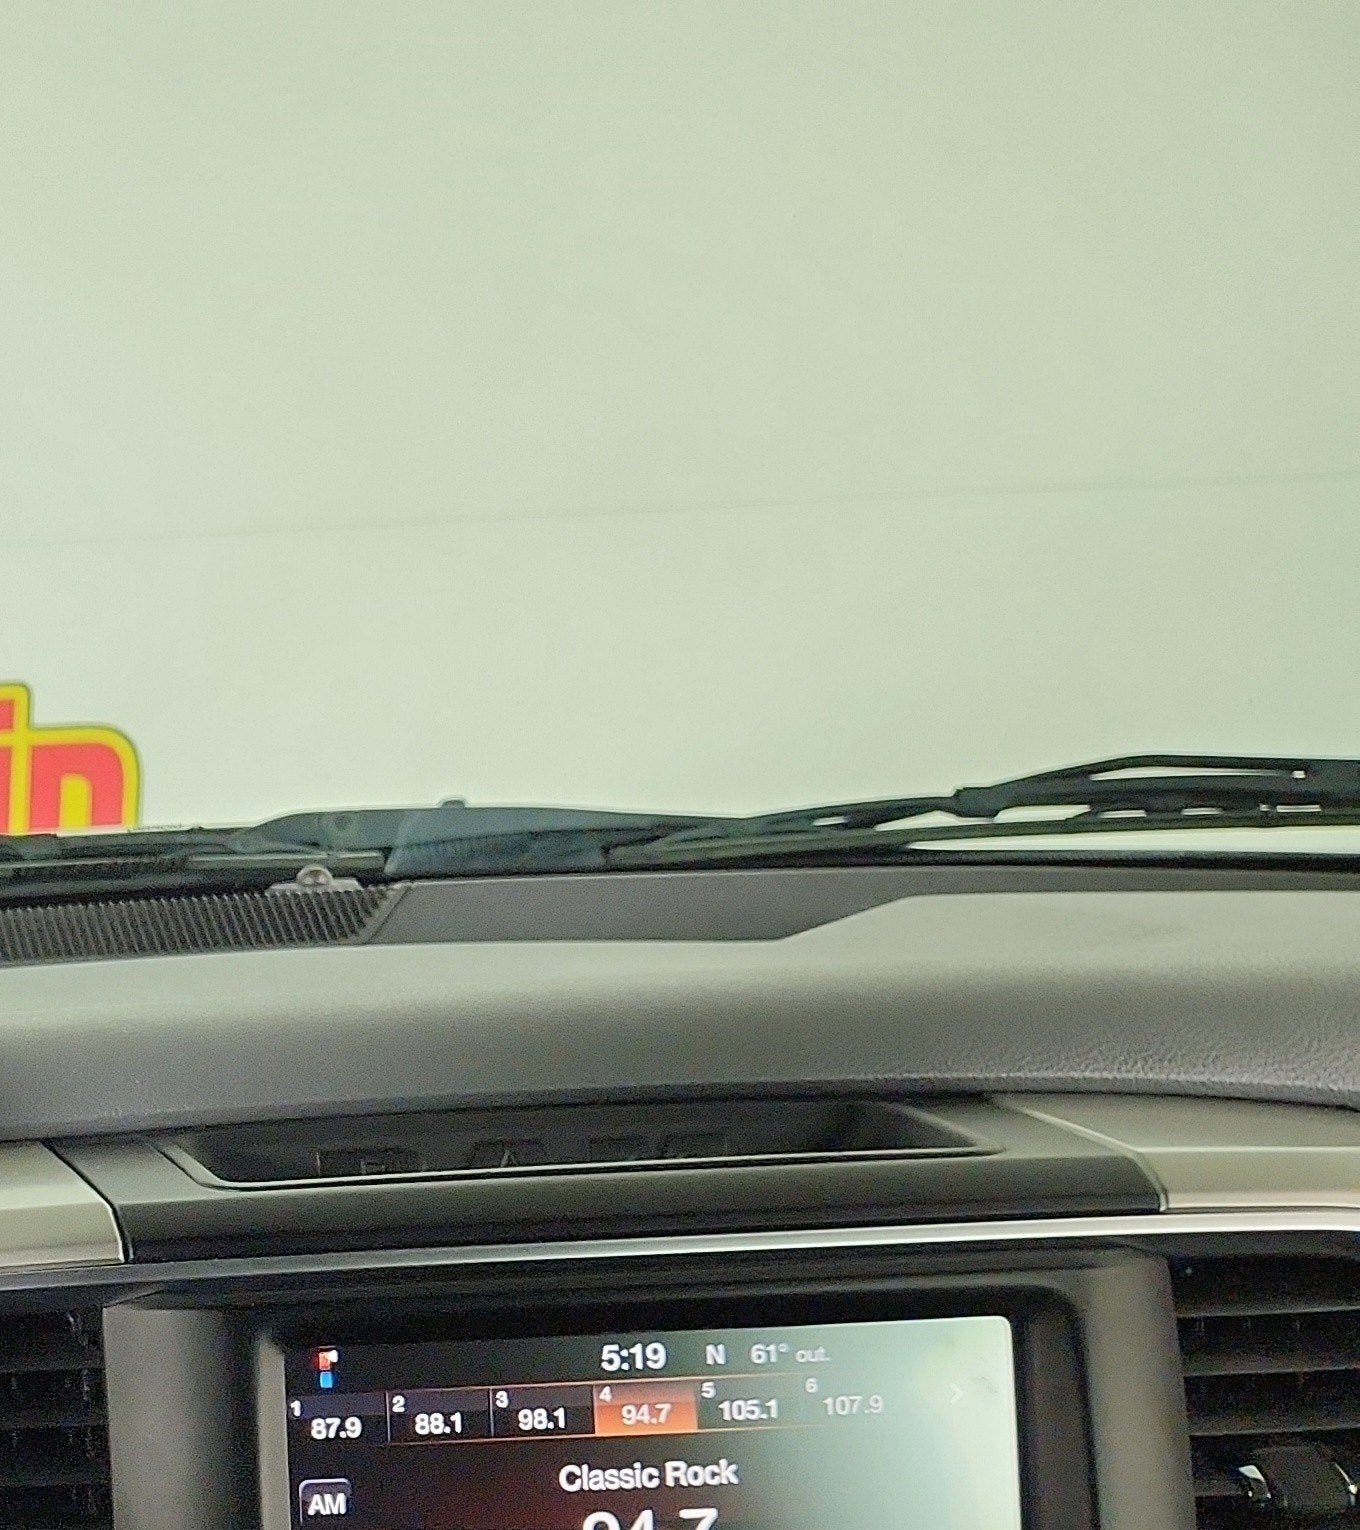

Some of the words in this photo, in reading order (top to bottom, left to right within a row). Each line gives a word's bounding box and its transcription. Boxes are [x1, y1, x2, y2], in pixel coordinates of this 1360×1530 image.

[601, 1342, 667, 1372] 5:19
[705, 1344, 726, 1365] N
[751, 1343, 788, 1365] 61°
[599, 1386, 612, 1402] 4
[701, 1382, 716, 1399] 5
[805, 1379, 818, 1394] 6
[290, 1400, 302, 1417] 1
[392, 1396, 405, 1413] 2
[495, 1391, 509, 1408] 3
[718, 1399, 779, 1421] 105.1
[823, 1395, 884, 1416] 107.9
[415, 1412, 462, 1436] 88.1
[518, 1408, 566, 1431] 98.1
[621, 1403, 671, 1426] 94.7
[310, 1417, 363, 1440] 87.9
[559, 1462, 660, 1493] Classic
[665, 1459, 739, 1487] Rock
[307, 1494, 347, 1515] AM
